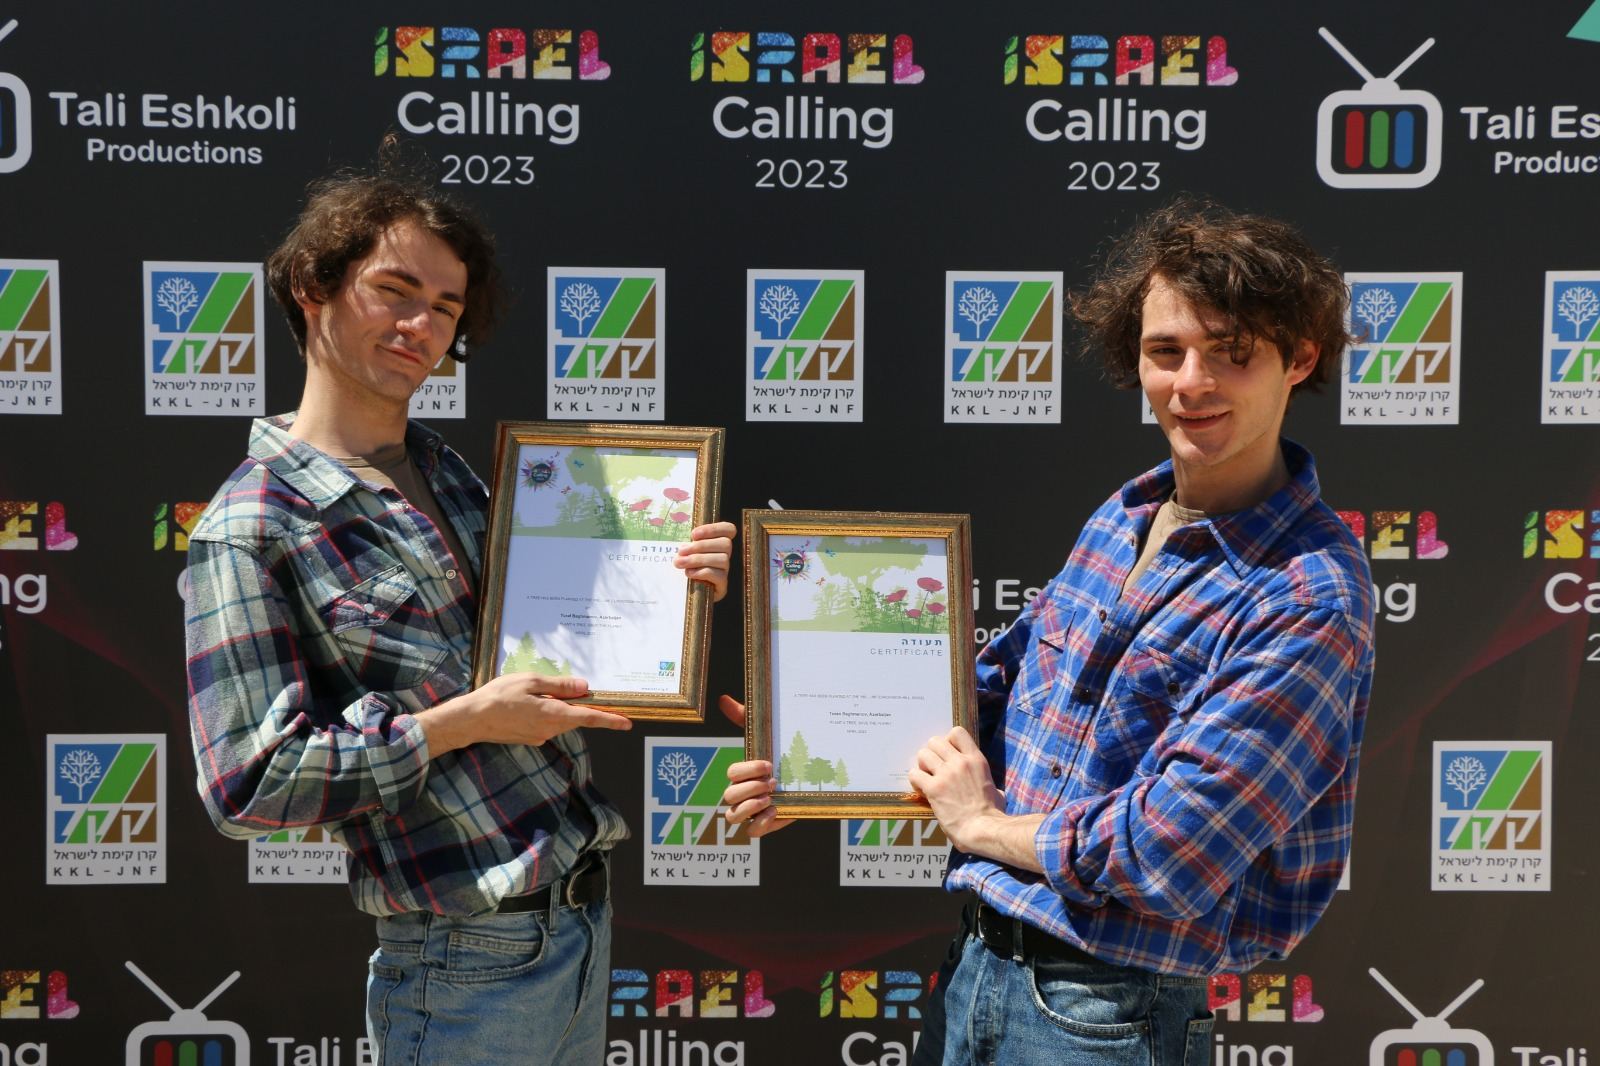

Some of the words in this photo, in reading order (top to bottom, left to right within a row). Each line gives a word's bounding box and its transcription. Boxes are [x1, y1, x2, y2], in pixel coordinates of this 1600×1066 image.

[49, 92, 125, 126] Tali
[142, 94, 295, 130] Eshkoli
[397, 91, 579, 145] Calling
[713, 96, 893, 149] Calling
[1026, 98, 1206, 150] Calling
[1460, 106, 1535, 140] Tali
[88, 139, 262, 164] Productions
[1495, 150, 1600, 174] Produc
[442, 155, 534, 185] 2023
[756, 159, 848, 188] 2023
[1068, 162, 1160, 191] 2023
[33, 379, 52, 392] קרן
[152, 379, 197, 391] לישראל
[201, 381, 232, 393] קימת
[236, 382, 256, 393] קרן
[437, 384, 457, 396] קרן
[554, 383, 598, 395] לישראל
[753, 385, 796, 397] לישראל
[601, 386, 633, 398] קימת
[636, 386, 656, 398] קרן
[800, 388, 831, 399] קימת
[835, 388, 854, 400] קרן
[951, 387, 994, 399] לישראל
[998, 390, 1030, 401] קימת
[1033, 390, 1053, 401] קרן
[1348, 389, 1392, 400] לישראל
[1395, 391, 1427, 402] קימת
[1430, 391, 1450, 402] קרן
[1549, 388, 1593, 399] לישראל
[608, 553, 675, 563] CERTIFICAT
[901, 637, 942, 647] תעודה
[870, 648, 943, 657] CERTIFICATE
[53, 849, 98, 861] לישראל
[102, 850, 134, 861] קימת
[137, 850, 157, 861] קרן
[255, 848, 299, 859] לישראל
[650, 850, 694, 862] לישראל
[697, 852, 728, 864] קימת
[732, 853, 751, 864] קרן
[847, 851, 890, 863] לישראל
[893, 853, 924, 865] קימת
[928, 854, 948, 865] קרן
[1439, 855, 1482, 866] לישראל
[1486, 857, 1518, 868] קימת
[1522, 857, 1542, 868] קרן
[611, 969, 775, 1018] RAEL
[1207, 973, 1324, 1022] AEL
[267, 1037, 340, 1066] Tali
[606, 1029, 745, 1066] alling
